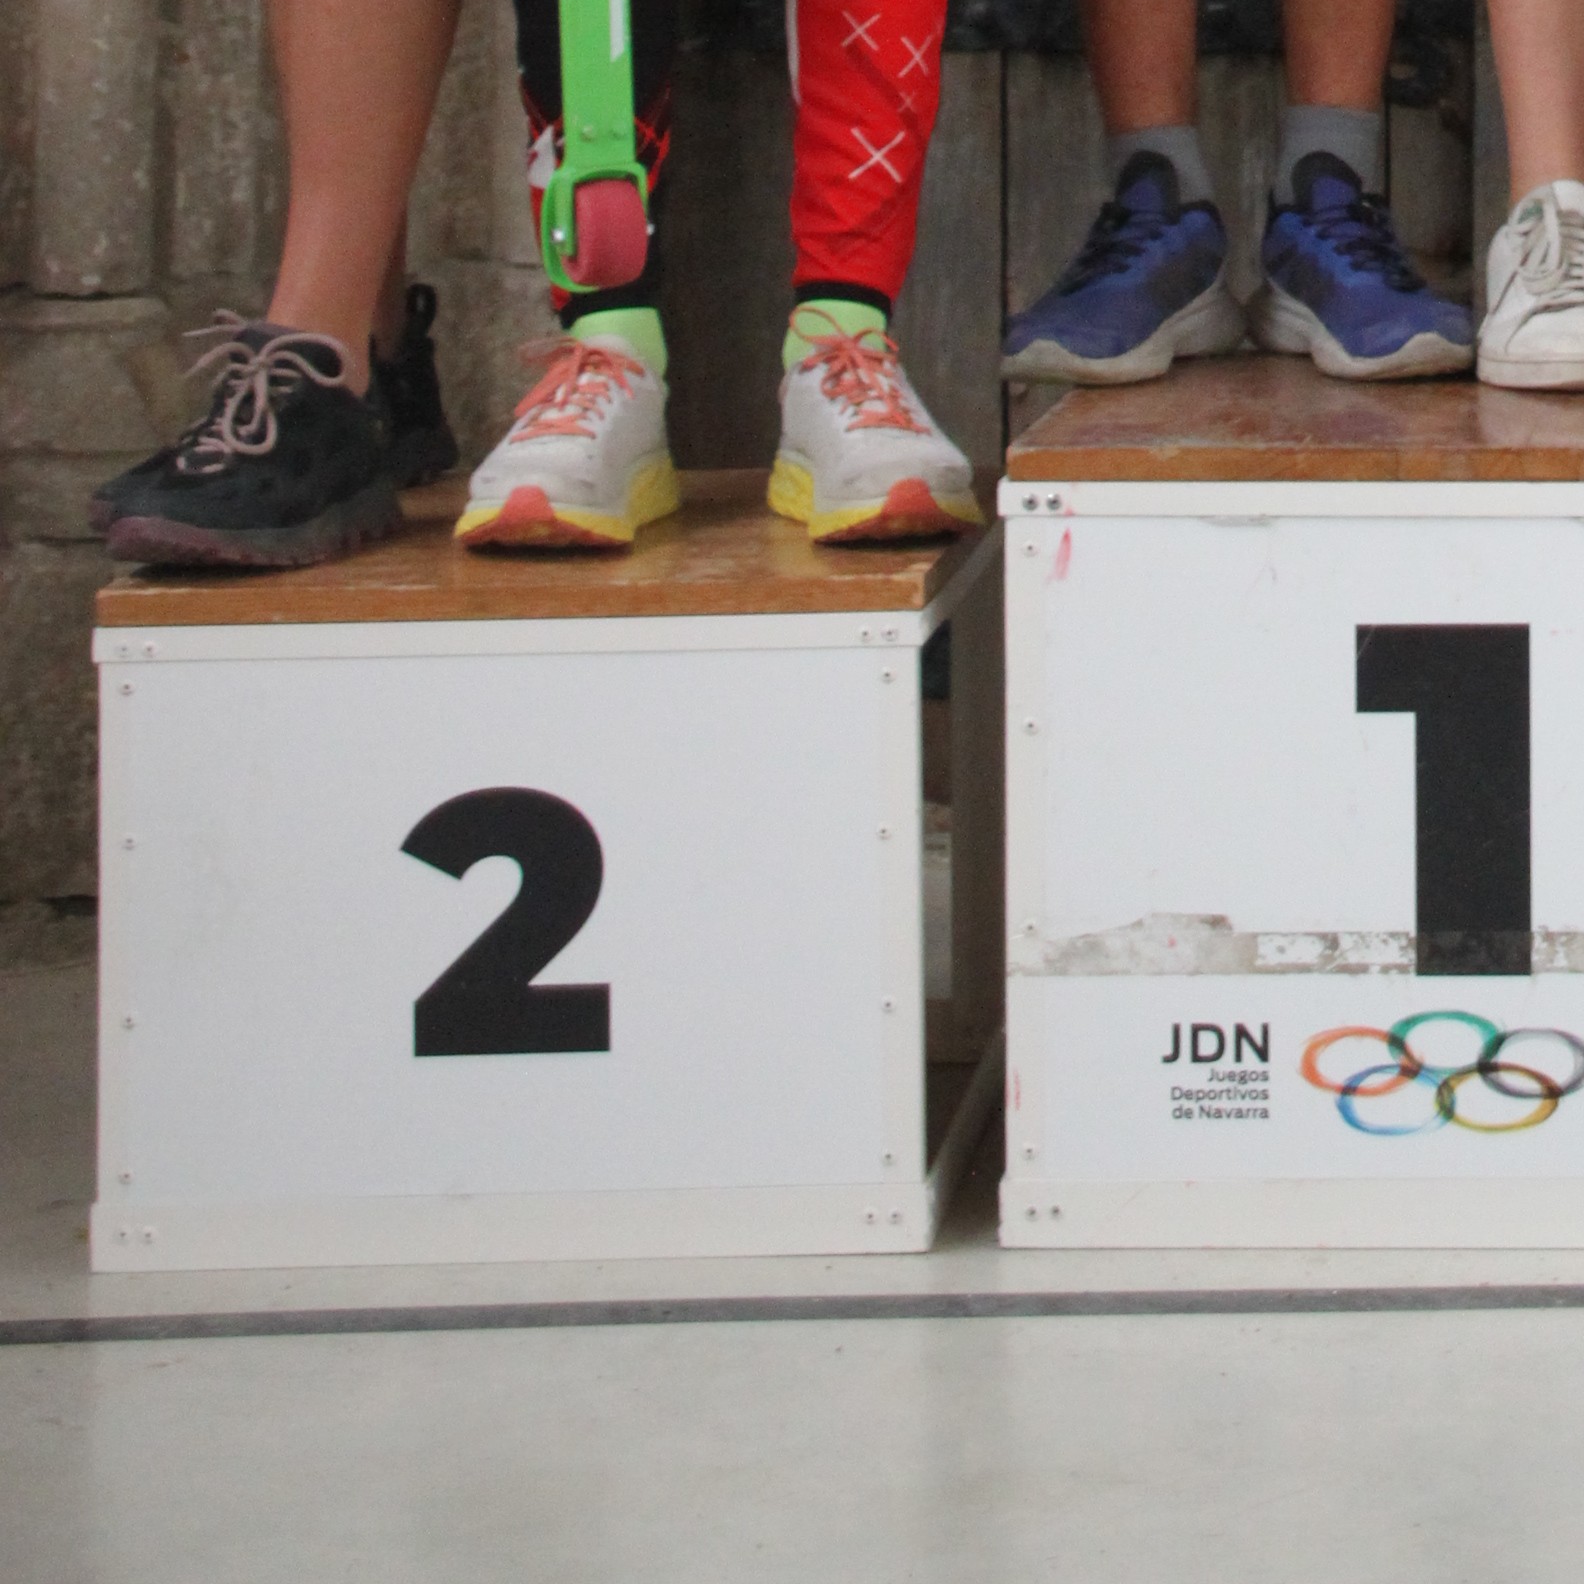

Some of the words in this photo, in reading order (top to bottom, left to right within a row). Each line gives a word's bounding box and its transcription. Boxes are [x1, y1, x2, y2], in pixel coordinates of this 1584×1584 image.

[1356, 623, 1532, 977] 1
[399, 786, 612, 1057] 2
[1162, 1022, 1270, 1064] JDN
[1207, 1068, 1270, 1085] Juegos
[1170, 1086, 1270, 1103] Deportivos
[1172, 1104, 1194, 1120] de
[1199, 1105, 1270, 1120] Navarra
